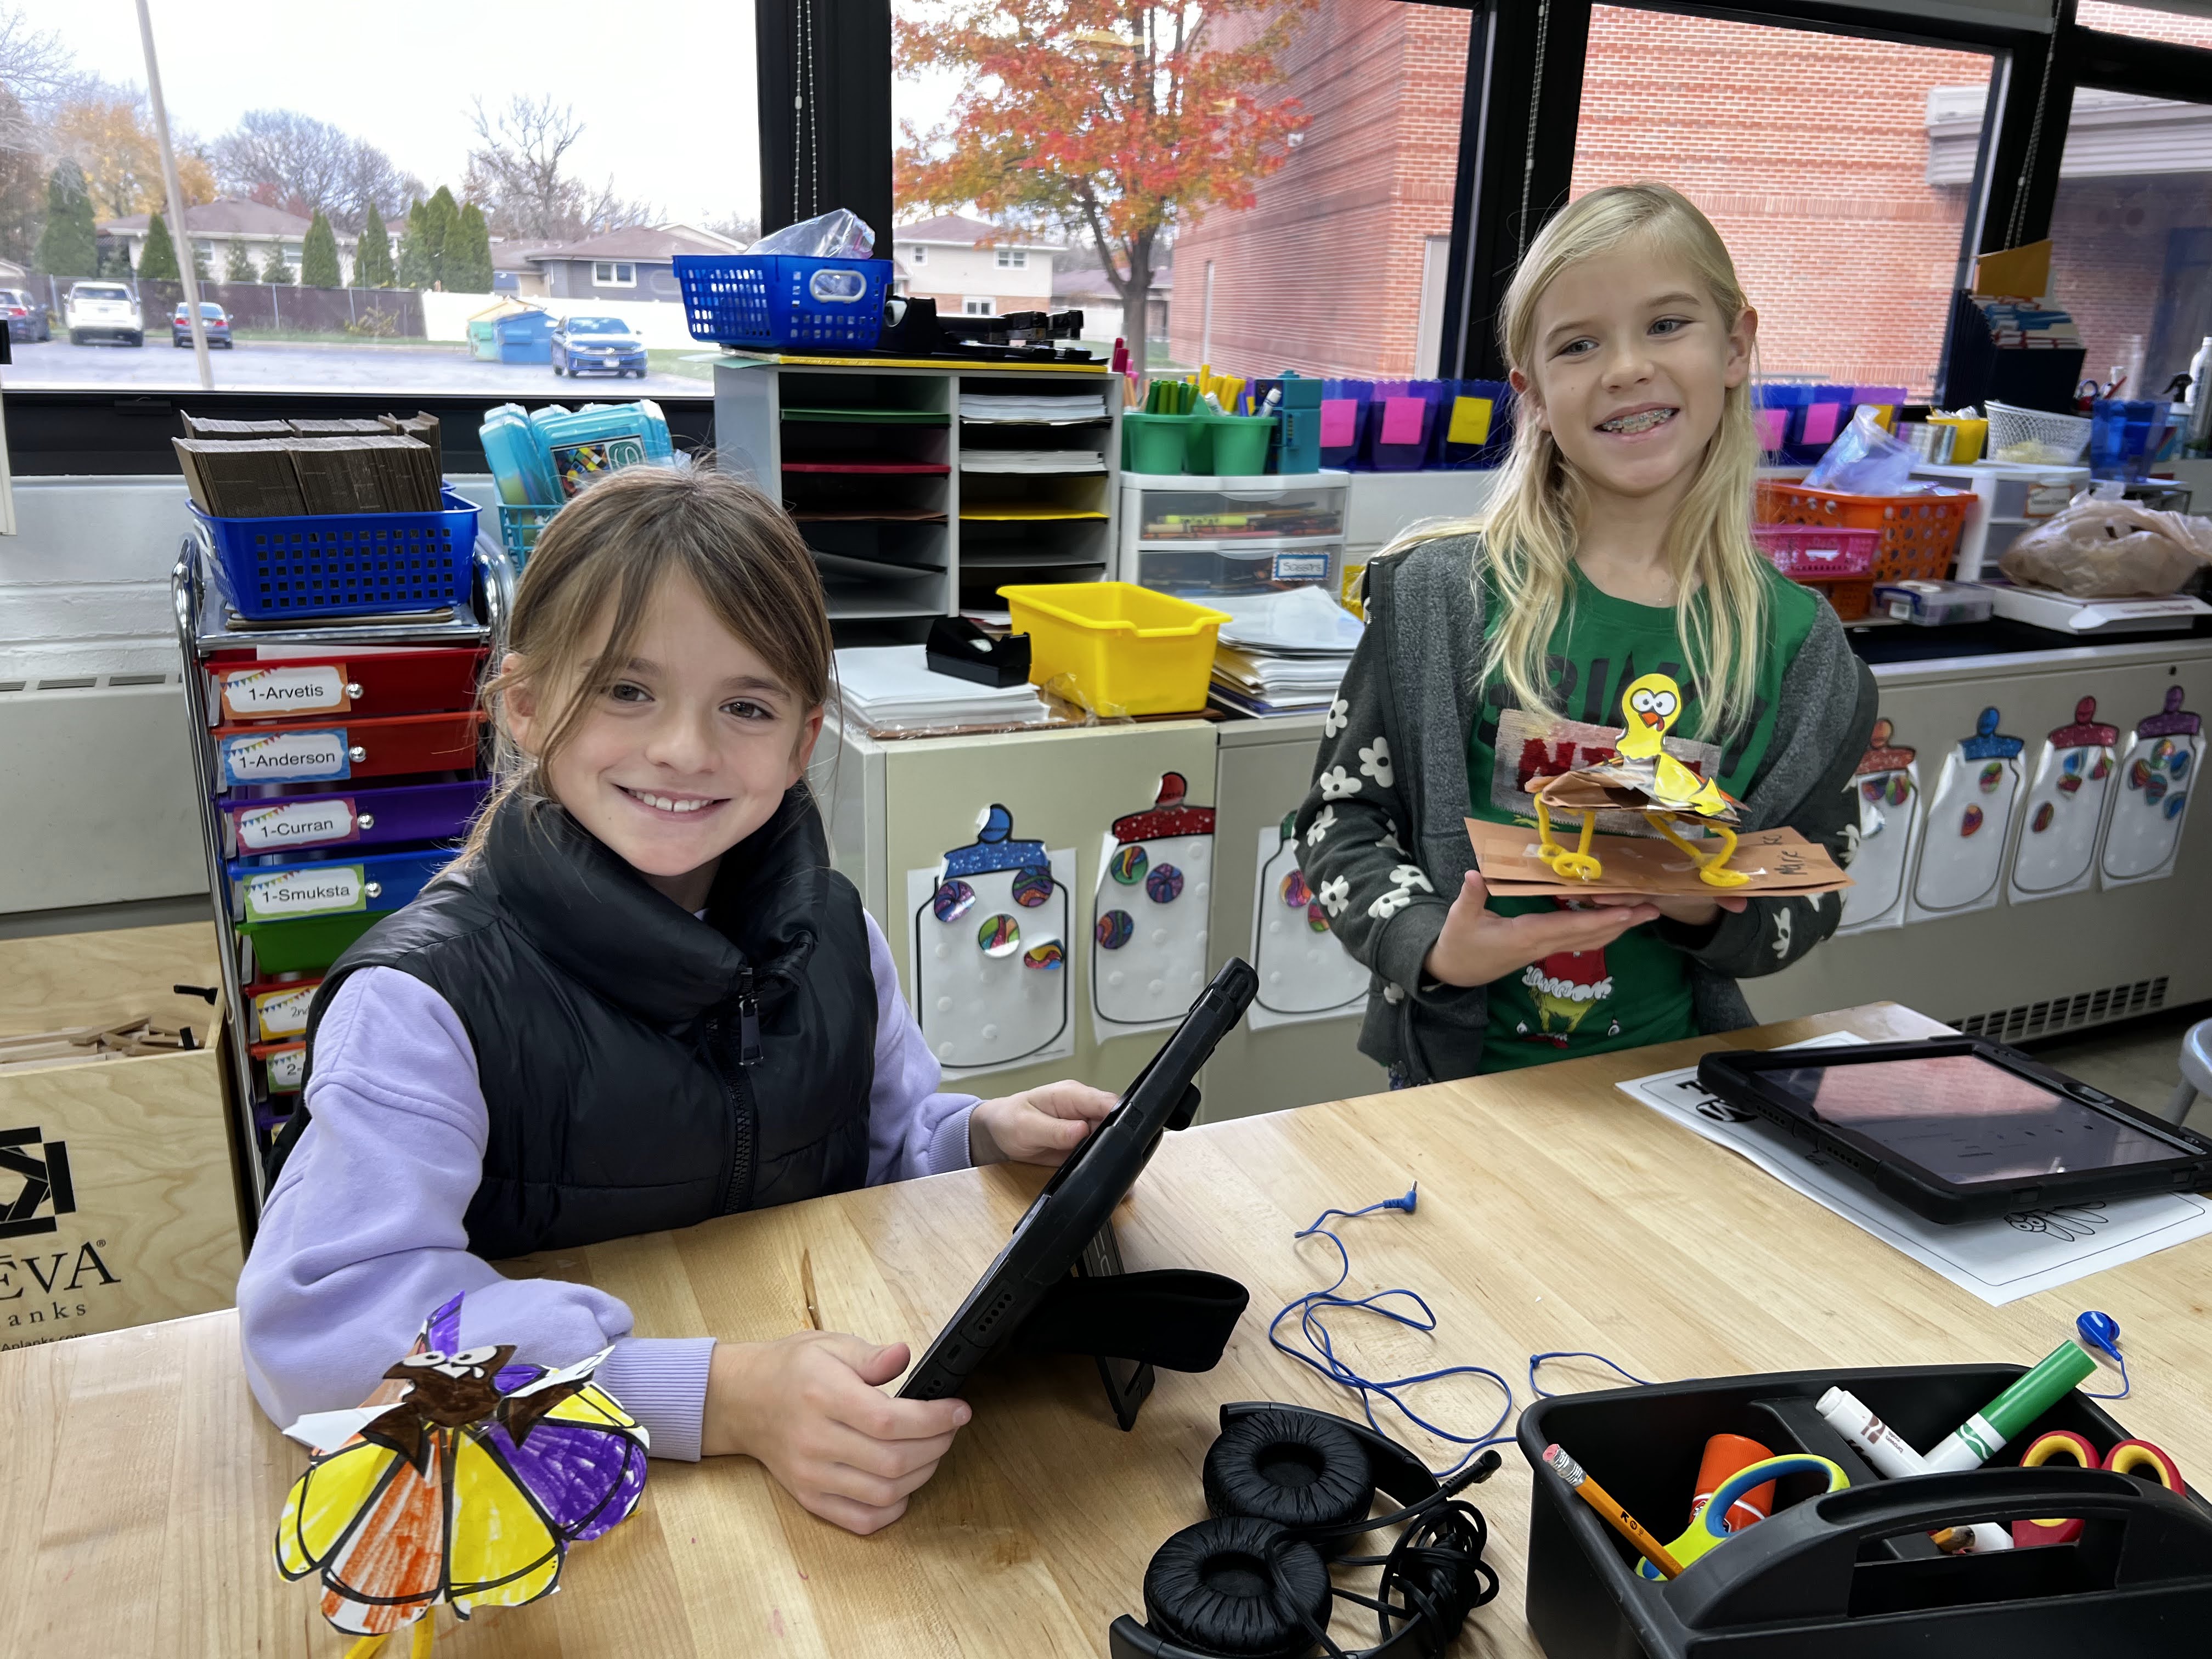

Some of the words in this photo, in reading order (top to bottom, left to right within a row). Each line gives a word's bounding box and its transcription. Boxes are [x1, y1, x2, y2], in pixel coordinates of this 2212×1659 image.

[249, 684, 324, 701] 1-Arvetis
[239, 752, 336, 768] 1-Anderson
[261, 820, 334, 838] 1-Curran
[262, 885, 350, 903] 1-Smuksta
[8, 1302, 87, 1327] anks
[1886, 1435, 1904, 1454] brown
